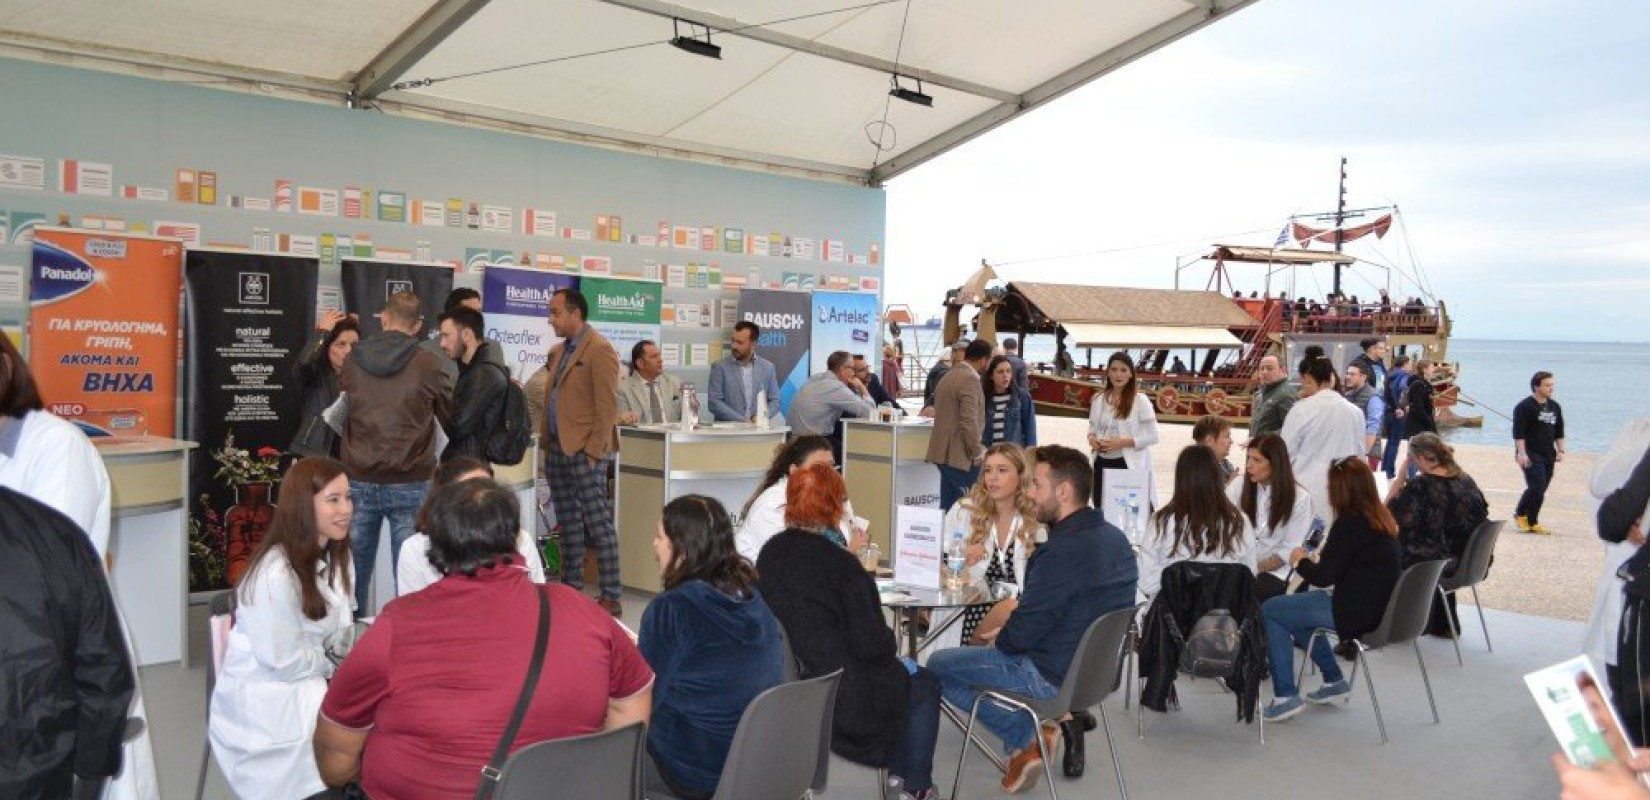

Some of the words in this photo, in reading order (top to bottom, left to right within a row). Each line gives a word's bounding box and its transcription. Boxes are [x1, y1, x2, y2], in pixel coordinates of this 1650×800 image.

[41, 266, 92, 281] Panadol
[828, 306, 869, 324] Artelac
[49, 318, 71, 331] ΓΙΑ
[235, 326, 271, 337] natural
[85, 336, 133, 351] ΓΡΙΠΗ,
[60, 354, 112, 366] ΑΚΟΜΑ
[114, 355, 140, 366] ΚΑΙ
[231, 362, 275, 373] effective
[82, 372, 154, 392] ΒΗΧΑ
[233, 394, 270, 404] holistic
[52, 404, 84, 416] ΝΕΟ
